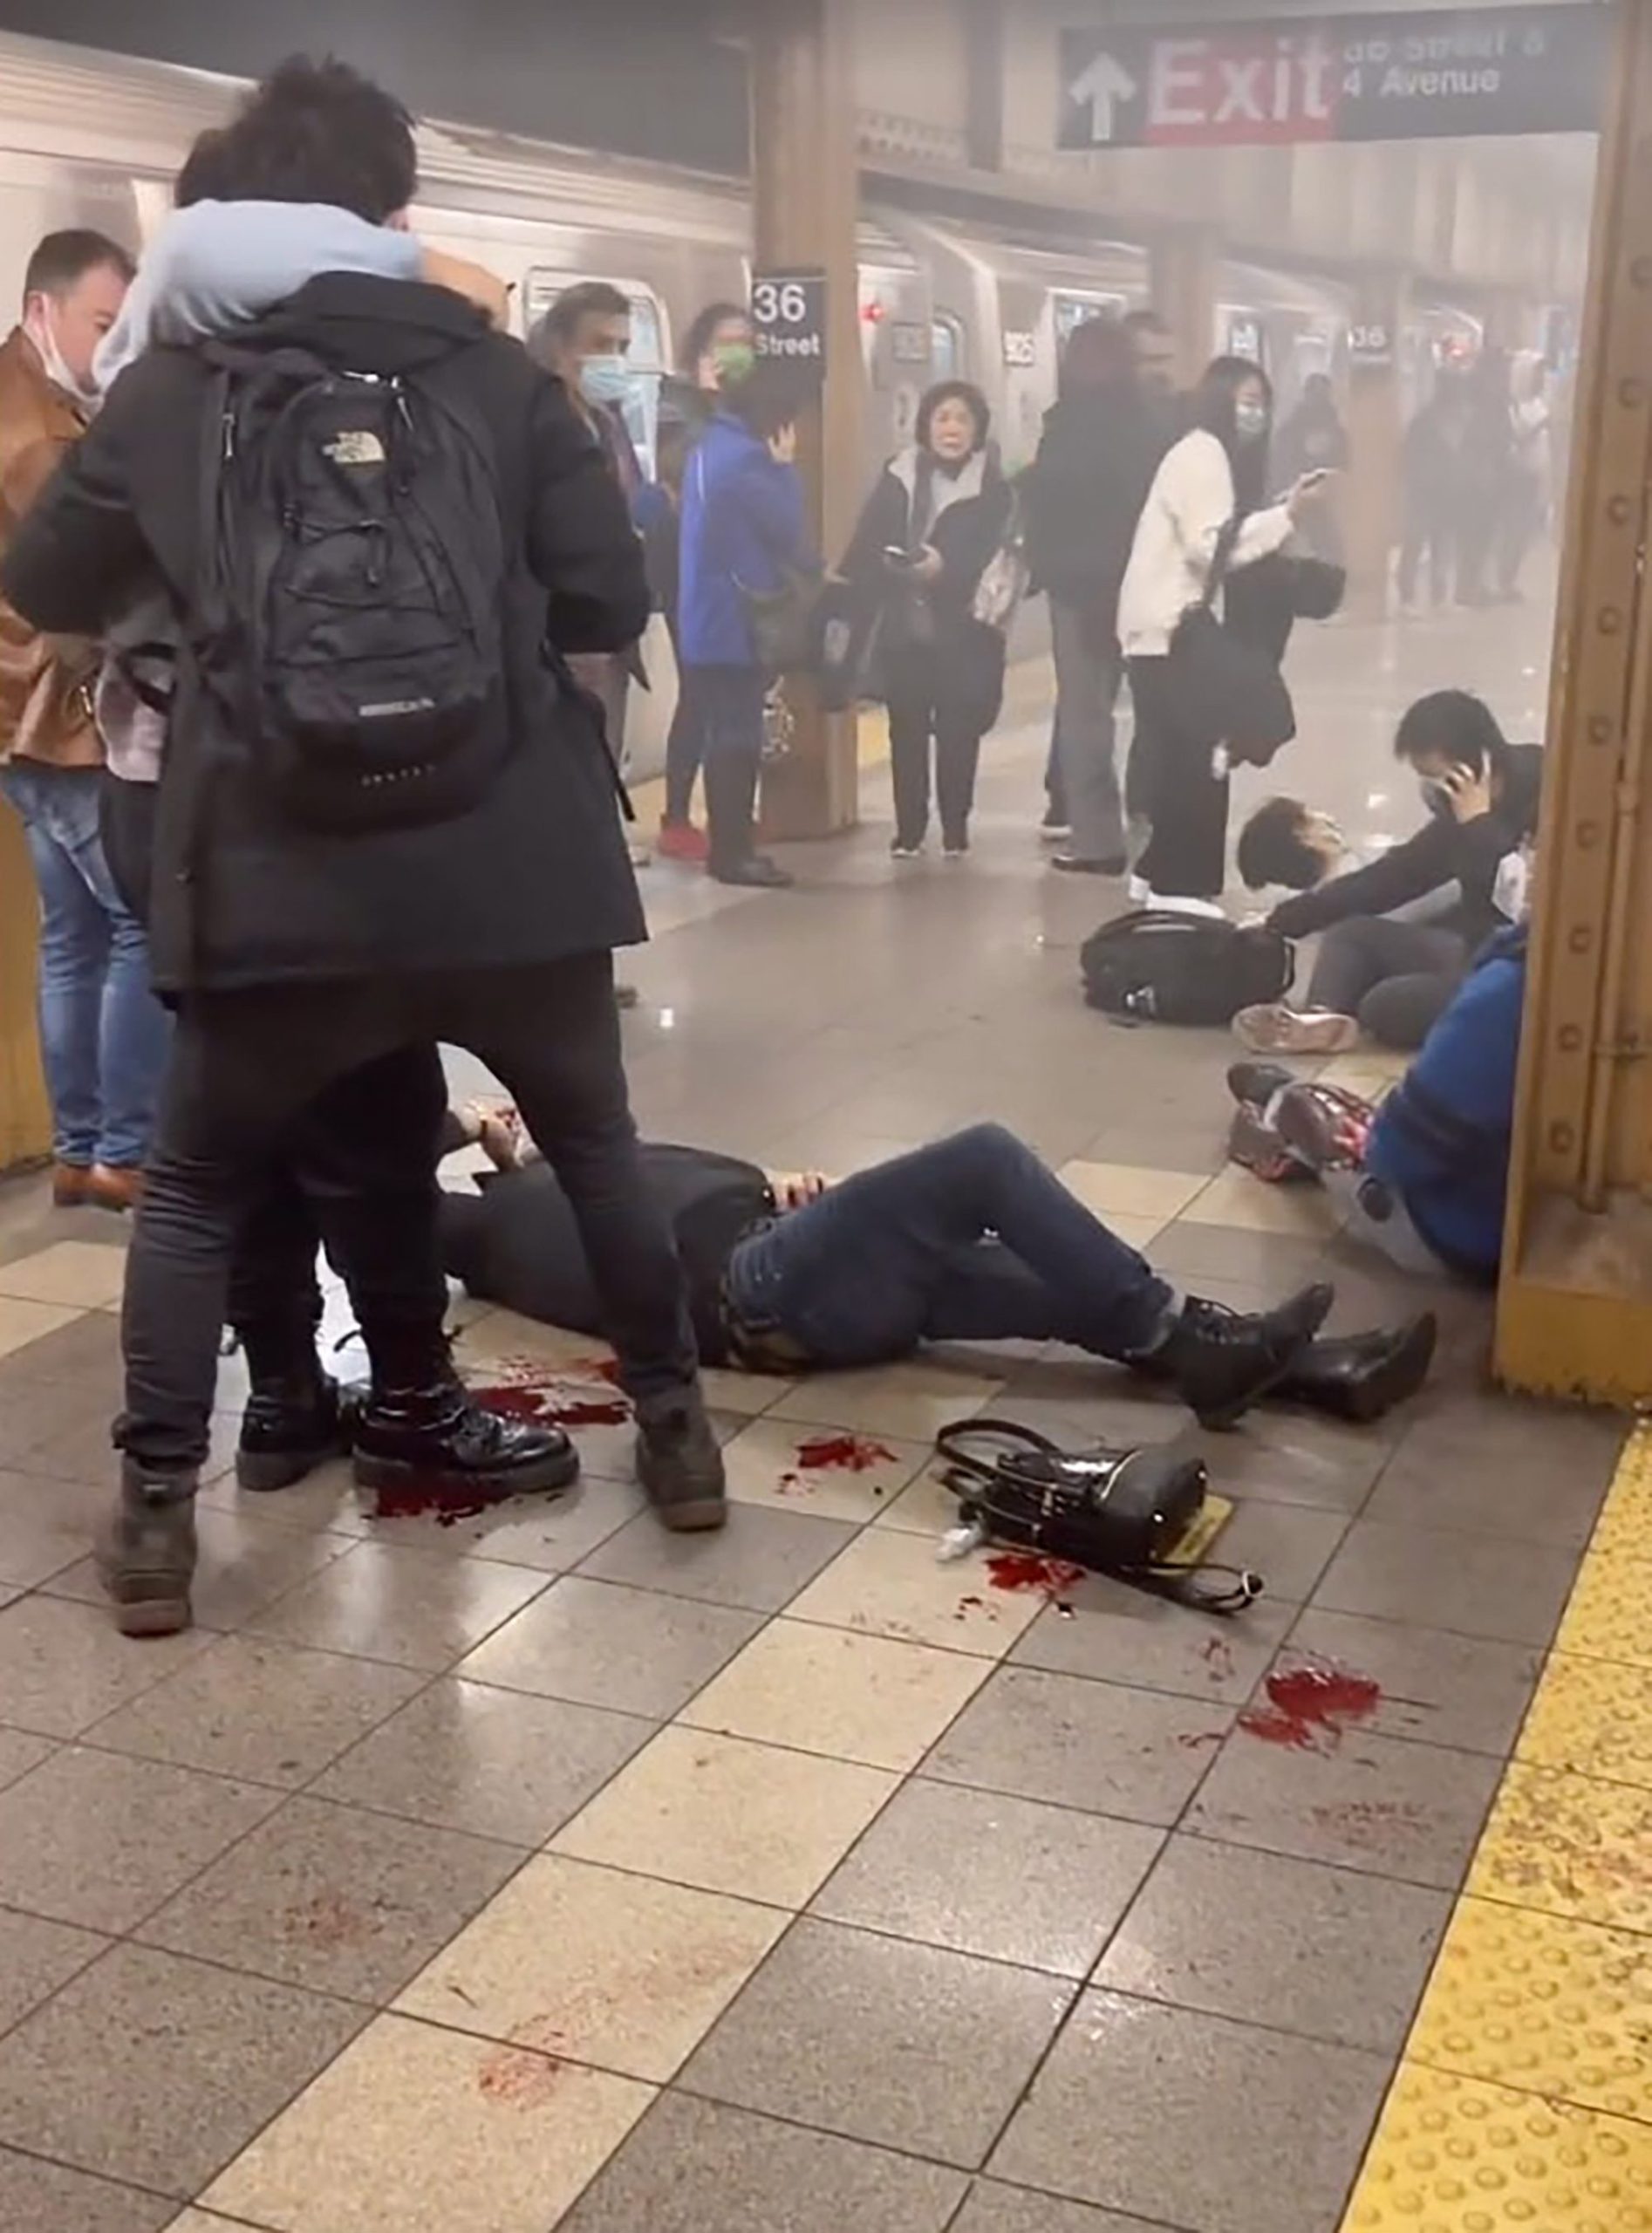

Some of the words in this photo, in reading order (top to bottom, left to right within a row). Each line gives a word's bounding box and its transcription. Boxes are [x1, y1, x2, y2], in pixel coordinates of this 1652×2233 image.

[1147, 37, 1334, 127] Exit
[1343, 65, 1361, 97] 4
[1380, 66, 1501, 97] Avenue
[754, 283, 806, 324] 36
[756, 332, 821, 356] Street
